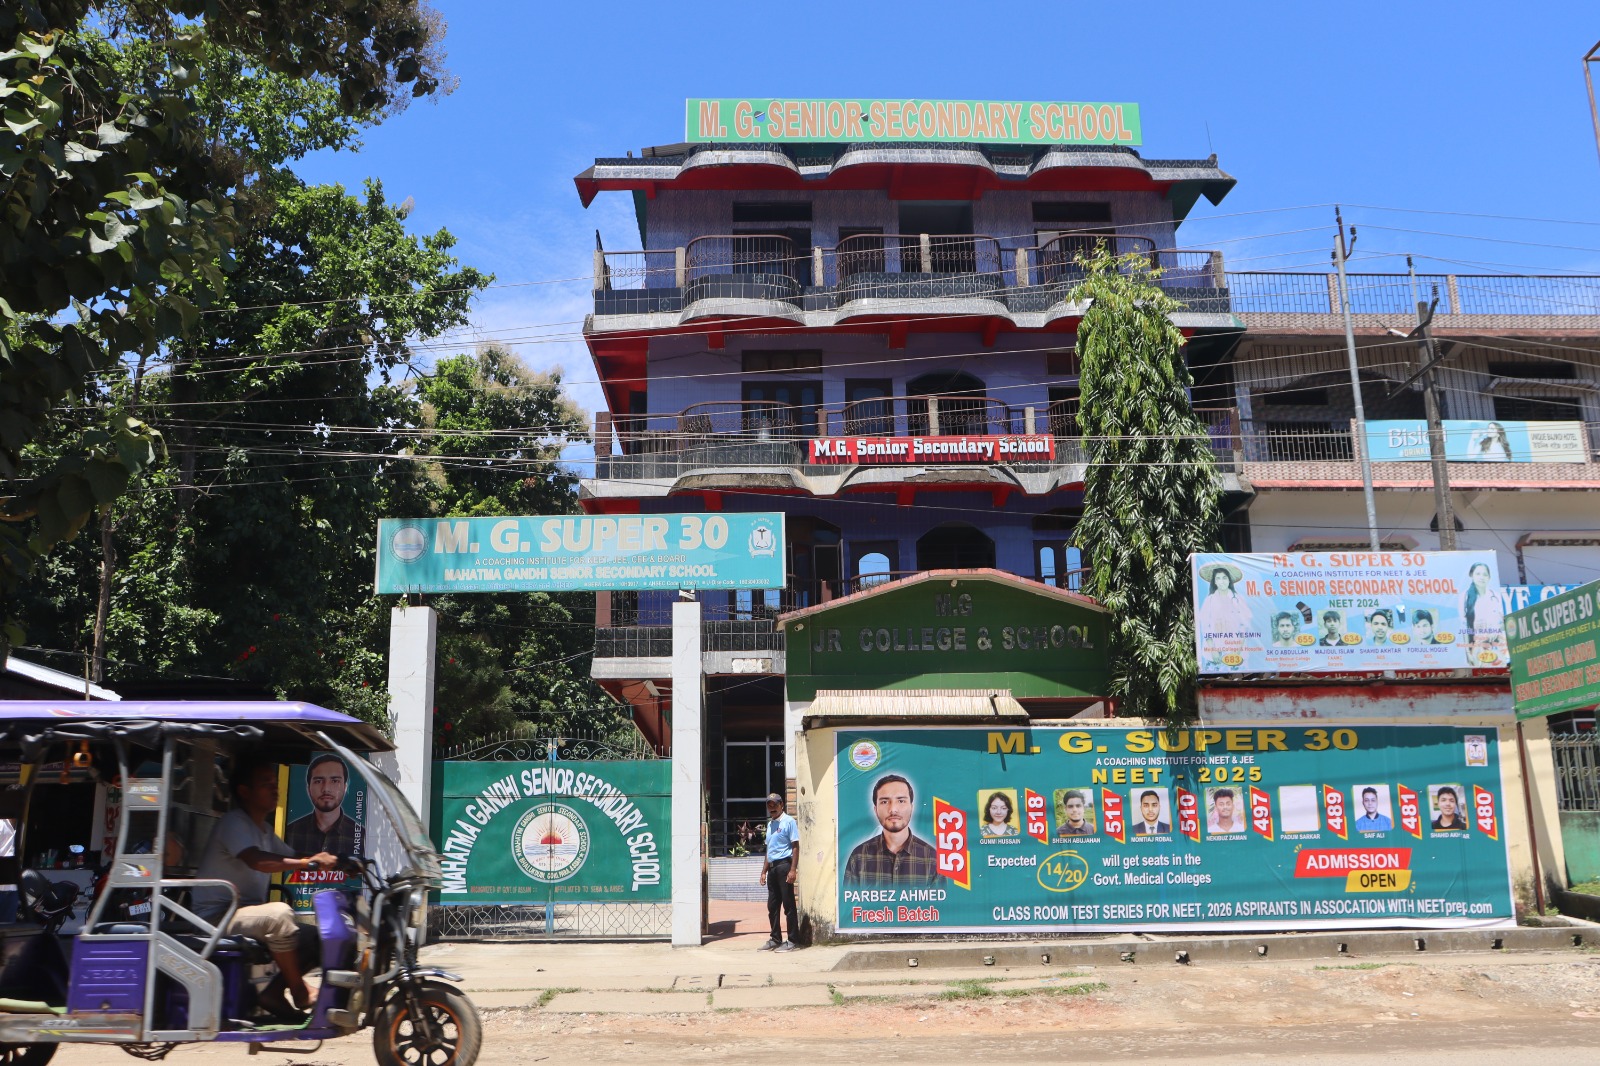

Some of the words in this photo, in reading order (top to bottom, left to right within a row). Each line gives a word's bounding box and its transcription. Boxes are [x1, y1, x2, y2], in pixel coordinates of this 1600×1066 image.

[700, 101, 727, 138] M.
[734, 102, 761, 139] G.
[768, 101, 865, 139] SENIOR
[870, 102, 1021, 139] SECONDARY
[1029, 102, 1133, 140] SCHOOL
[814, 439, 851, 456] M.G.
[857, 438, 909, 455] Senior
[913, 437, 994, 457] Secondary
[999, 436, 1051, 453] School
[1388, 424, 1447, 448] Bislei
[434, 520, 479, 553] M.
[490, 519, 530, 552] G.
[541, 515, 668, 552] SUPER
[678, 515, 729, 550] 30
[482, 557, 525, 566] COACHING
[526, 556, 567, 566] INSTITUTE
[569, 556, 585, 564] FOR
[649, 555, 656, 563] &
[657, 555, 687, 563] BOARD
[1272, 553, 1294, 568] M.
[1300, 553, 1323, 568] G.
[1329, 553, 1395, 568] SUPER
[1401, 553, 1426, 567] 30
[444, 567, 501, 581] MAHATMA
[503, 567, 548, 580] GANDHI
[550, 566, 593, 580] SENIOR
[595, 565, 667, 579] SECONDARY
[669, 564, 718, 578] SCHOOL
[1281, 570, 1323, 578] COACHING
[1413, 569, 1428, 577] JEE
[1246, 580, 1261, 597] M.
[1263, 580, 1277, 597] G.
[1279, 580, 1327, 597] SENIOR
[1329, 579, 1404, 596] SECONDARY
[1408, 578, 1458, 596] SCHOOL
[1329, 599, 1354, 608] NEET
[1356, 598, 1380, 608] 2024
[1518, 616, 1532, 640] M.
[1531, 611, 1544, 636] G.
[1542, 598, 1578, 630] SUPER
[1577, 593, 1594, 621] 30
[813, 628, 842, 652] JR
[858, 627, 967, 652] COLLEGE
[977, 626, 992, 650] &
[1002, 624, 1095, 651] SCHOOL
[1344, 634, 1360, 644] 634
[1437, 632, 1453, 642] 595
[1576, 622, 1591, 634] NEET
[1297, 635, 1314, 644] 655
[1224, 655, 1241, 664] 683
[1526, 649, 1565, 677] MAHATMA
[1564, 639, 1597, 667] GANDHI
[1515, 679, 1542, 702] SENIOR
[1541, 667, 1585, 697] SECONDARY
[987, 731, 1041, 755] M.
[1058, 730, 1108, 754] G.
[1125, 729, 1289, 753] SUPER
[1303, 728, 1359, 751] 30
[1095, 757, 1103, 766] A
[1103, 756, 1147, 766] COACHING
[1148, 756, 1190, 766] INSTITUTE
[1190, 755, 1207, 765] FOR
[1209, 755, 1230, 765] NEET
[1231, 755, 1238, 764] &
[1239, 755, 1255, 764] JEE
[1091, 767, 1163, 784] NEET
[1198, 765, 1263, 782] 2025
[355, 790, 364, 820] AHMED
[1027, 795, 1046, 835] 518
[1104, 795, 1122, 834] 511
[1180, 792, 1197, 833] 510
[1253, 791, 1269, 833] 497
[1326, 791, 1343, 831] 489
[1400, 791, 1418, 831] 481
[1476, 791, 1493, 832] 480
[353, 820, 363, 855] PARBEZ
[441, 818, 482, 894] MAHATMA
[465, 774, 523, 826] GANDHI
[521, 767, 575, 797] SENIOR
[573, 772, 649, 837] SECONDARY
[626, 831, 661, 892] SCHOOL
[936, 809, 966, 872] 553
[987, 855, 1037, 869] Expected
[1102, 854, 1121, 867] will
[1123, 854, 1141, 869] get
[1142, 853, 1171, 867] seats
[1172, 853, 1182, 866] in
[1184, 853, 1201, 866] the
[1305, 853, 1400, 870] ADMISSION
[1046, 862, 1083, 887] 14/20
[1093, 872, 1122, 886] Govt.
[1124, 872, 1164, 886] Medical
[1166, 871, 1212, 887] Colleges
[1360, 873, 1397, 888] OPEN
[843, 889, 897, 903] PARBEZ
[899, 888, 947, 903] AHMED
[852, 906, 893, 923] Fresh
[897, 905, 940, 922] Batch
[992, 906, 1031, 921] CLASS
[1033, 905, 1069, 921] ROOM
[1071, 904, 1100, 920] TEST
[1102, 903, 1146, 920] SERIES
[1148, 903, 1170, 919] FOR
[1172, 902, 1205, 920] NEET,
[1207, 901, 1233, 917] 2026
[1234, 901, 1298, 917] ASPIRANTS
[1300, 900, 1312, 916] IN
[1314, 898, 1385, 916] ASSOCATION
[1387, 898, 1415, 914] WITH
[1417, 898, 1493, 916] NEETprep.com
